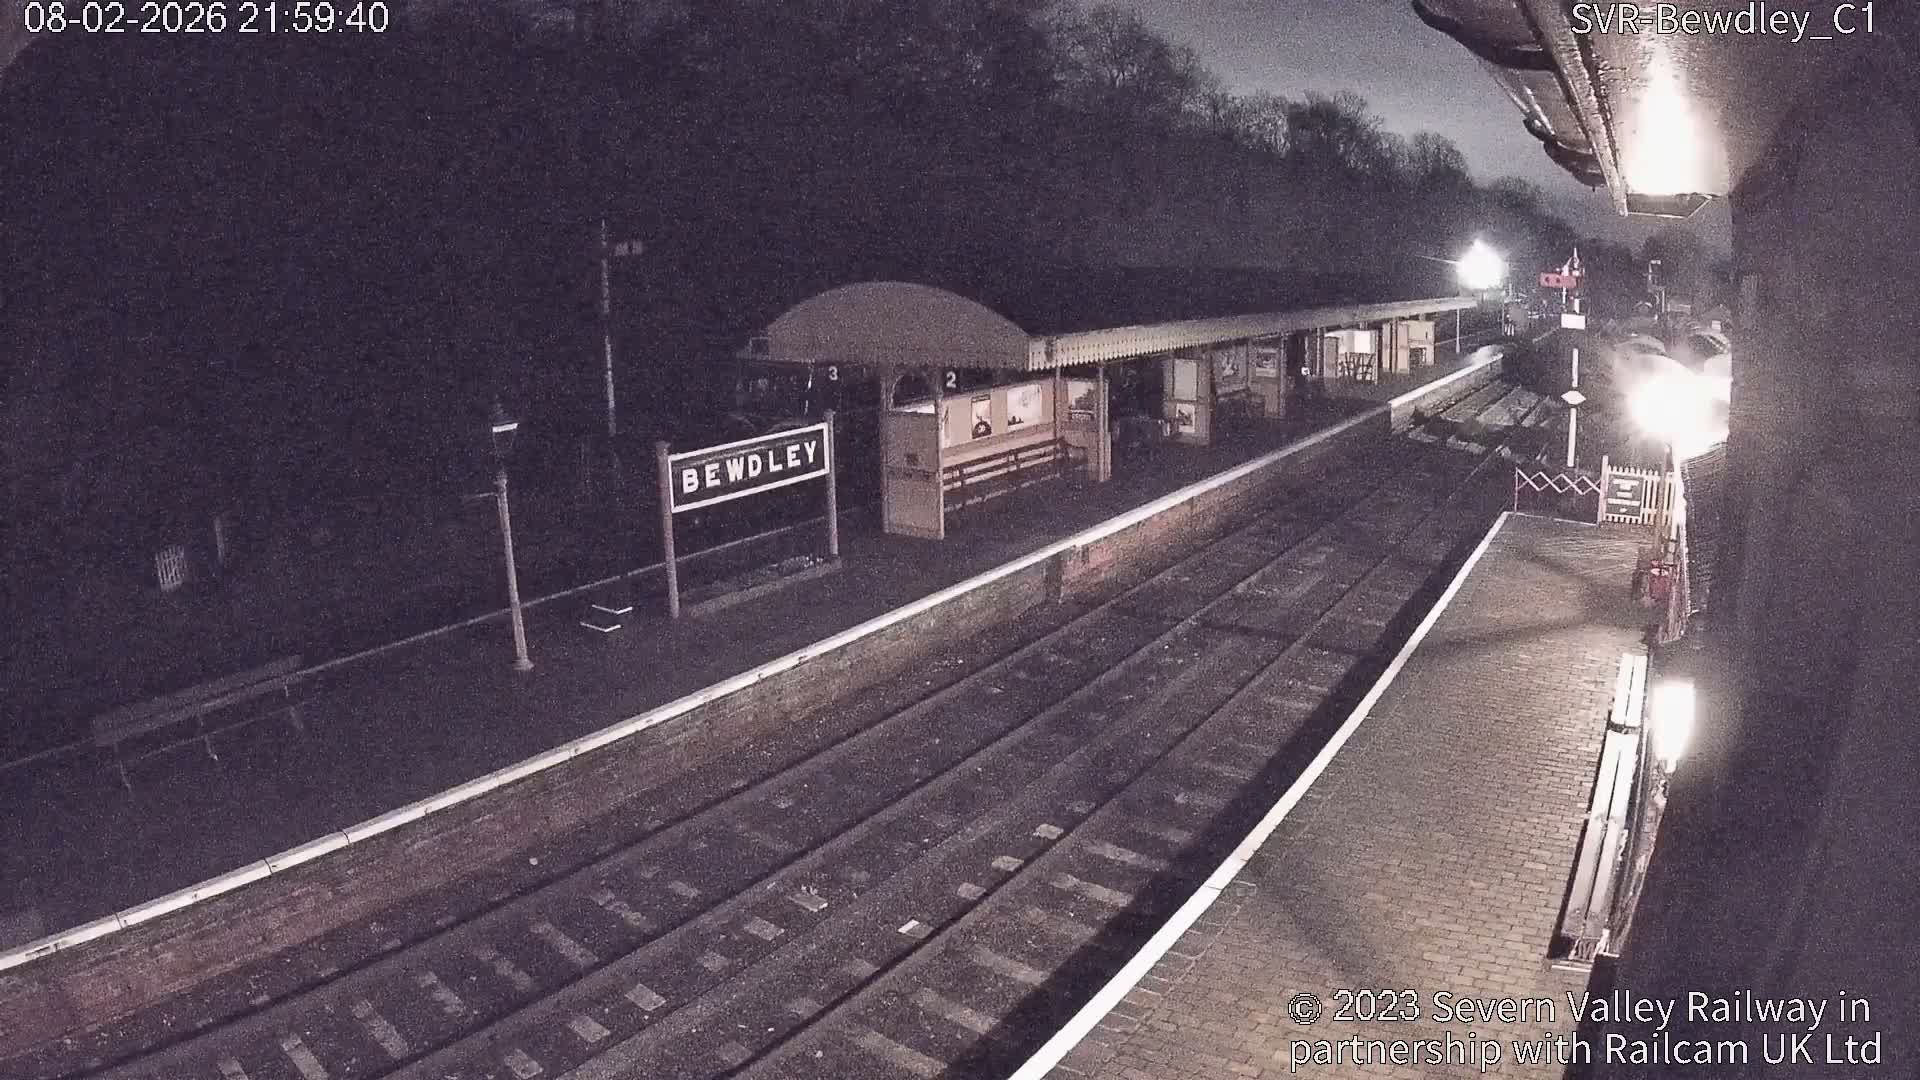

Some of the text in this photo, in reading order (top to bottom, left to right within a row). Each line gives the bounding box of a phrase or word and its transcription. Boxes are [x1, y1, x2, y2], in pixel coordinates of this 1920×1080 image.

[828, 365, 838, 381] 3
[946, 371, 957, 388] 2
[682, 440, 817, 494] BEWDLEY
